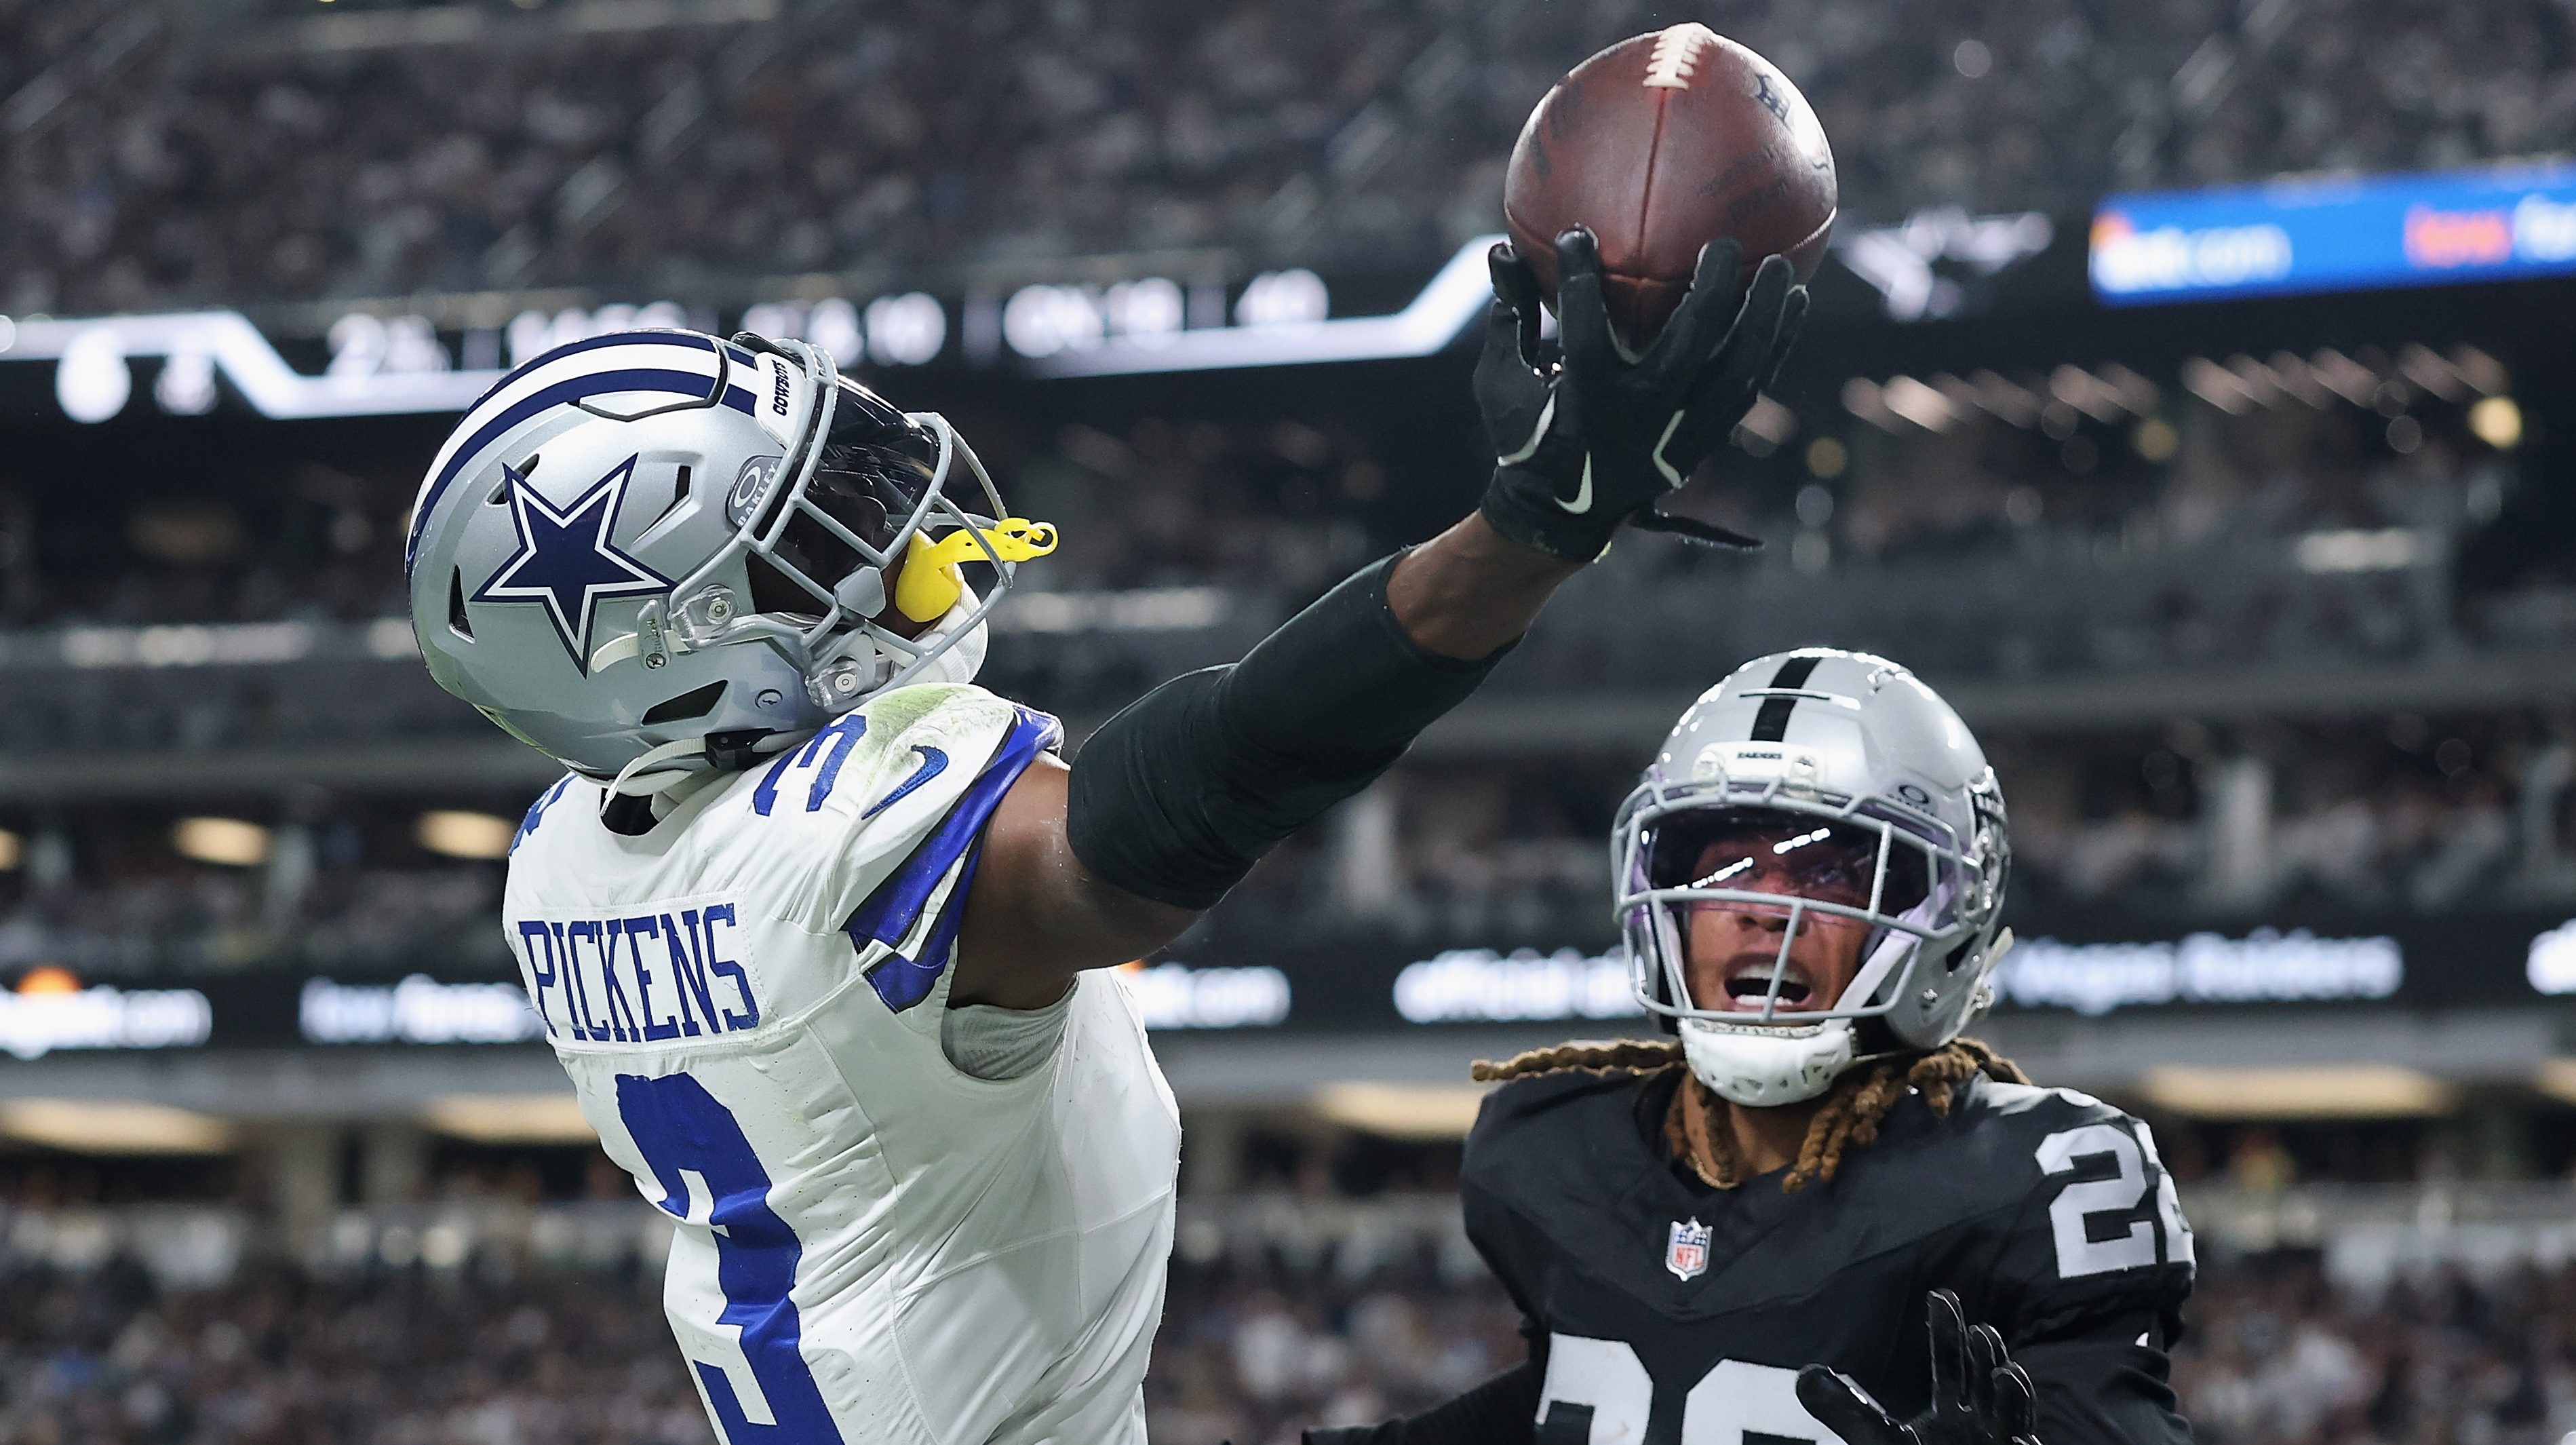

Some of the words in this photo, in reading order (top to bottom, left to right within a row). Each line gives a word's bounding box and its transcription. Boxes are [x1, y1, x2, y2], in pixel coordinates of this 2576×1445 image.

[772, 360, 788, 417] COWBOYS
[519, 902, 760, 1043] PICKENS
[1675, 1246, 1704, 1269] NFL
